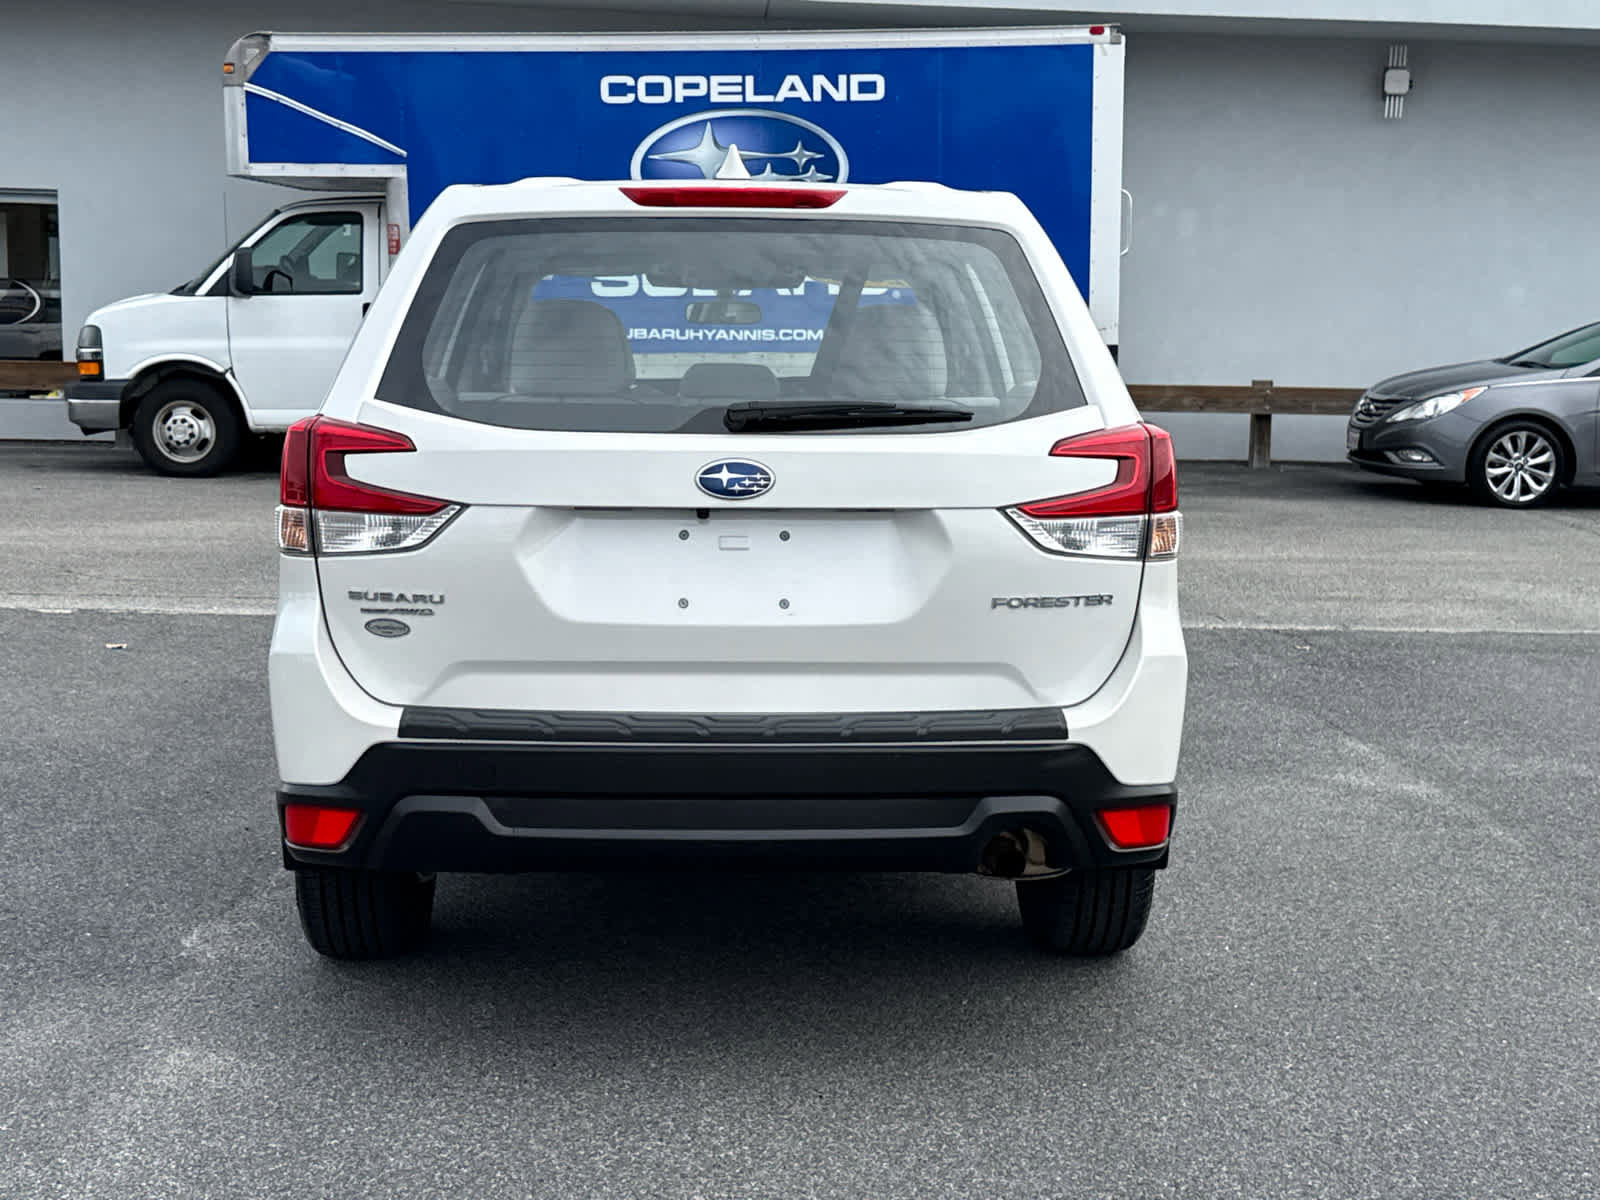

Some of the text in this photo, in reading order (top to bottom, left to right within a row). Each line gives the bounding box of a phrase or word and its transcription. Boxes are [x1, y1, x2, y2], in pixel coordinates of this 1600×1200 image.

[600, 73, 886, 104] COPELAND
[347, 591, 445, 604] SUBARU
[991, 593, 1114, 610] FORESTER
